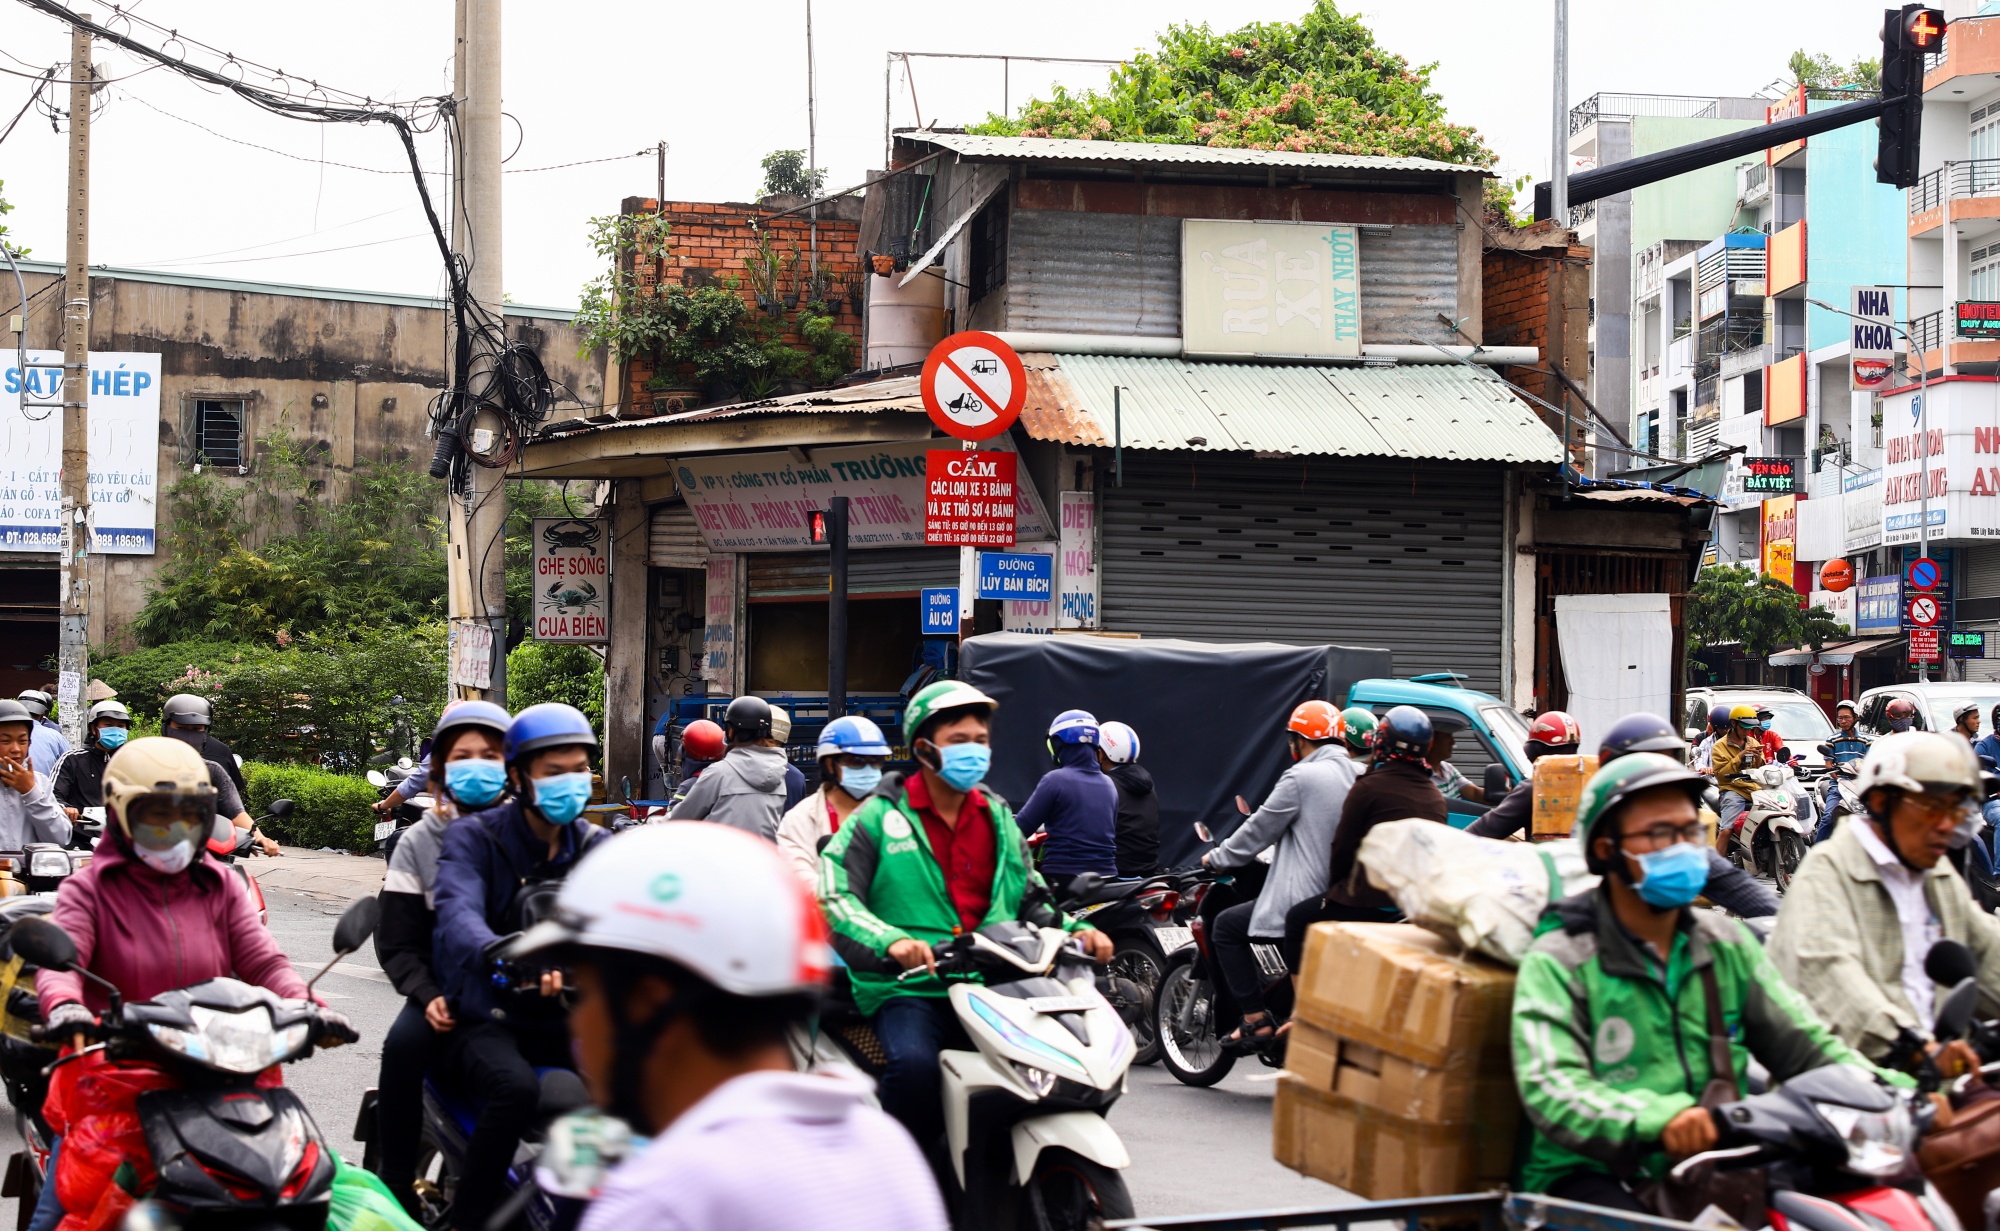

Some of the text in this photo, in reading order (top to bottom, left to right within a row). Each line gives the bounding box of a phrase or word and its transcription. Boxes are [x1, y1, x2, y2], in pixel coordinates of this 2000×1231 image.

[1274, 249, 1322, 329] XE
[1330, 286, 1357, 341] THAY
[1858, 290, 1889, 316] NHA
[1854, 325, 1893, 350] KHOA
[87, 363, 152, 396] HÉP
[1912, 428, 1945, 460] KOA
[1974, 426, 2000, 454] NH
[700, 475, 716, 490] VP
[731, 471, 764, 489] CÔNG
[761, 472, 779, 487] TY
[779, 464, 798, 486] CỔ
[796, 463, 833, 485] PHẦN
[947, 454, 997, 477] CẤM
[107, 471, 127, 484] YÊU
[130, 469, 152, 486] CẦU
[931, 477, 1012, 498] CÁC LOẠI XE 3 BÁNH
[1769, 475, 1792, 491] VIỆT
[92, 489, 113, 503] CÂY
[24, 508, 52, 520] COFA
[928, 498, 938, 516] VÀ
[941, 501, 951, 516] XE
[953, 499, 970, 517] THÔ
[972, 501, 984, 517] SƠ
[984, 503, 990, 517] 4
[992, 500, 1014, 518] BÁNH
[928, 519, 941, 530] SÁNG
[952, 521, 959, 530] 05
[989, 522, 996, 532] 13
[1006, 523, 1013, 532] 00
[989, 534, 996, 543] 22
[1006, 534, 1013, 543] 00
[538, 552, 605, 579] GHẸ SỐNG
[999, 558, 1035, 571] ĐƯỜNG
[982, 573, 1049, 593] LŨY BÁN BÍCH
[930, 592, 951, 605] ĐƯỜNG
[1062, 586, 1094, 618] PHÒNG
[538, 612, 605, 637] CUA BIỂN
[928, 608, 953, 626] ÂU CƠ
